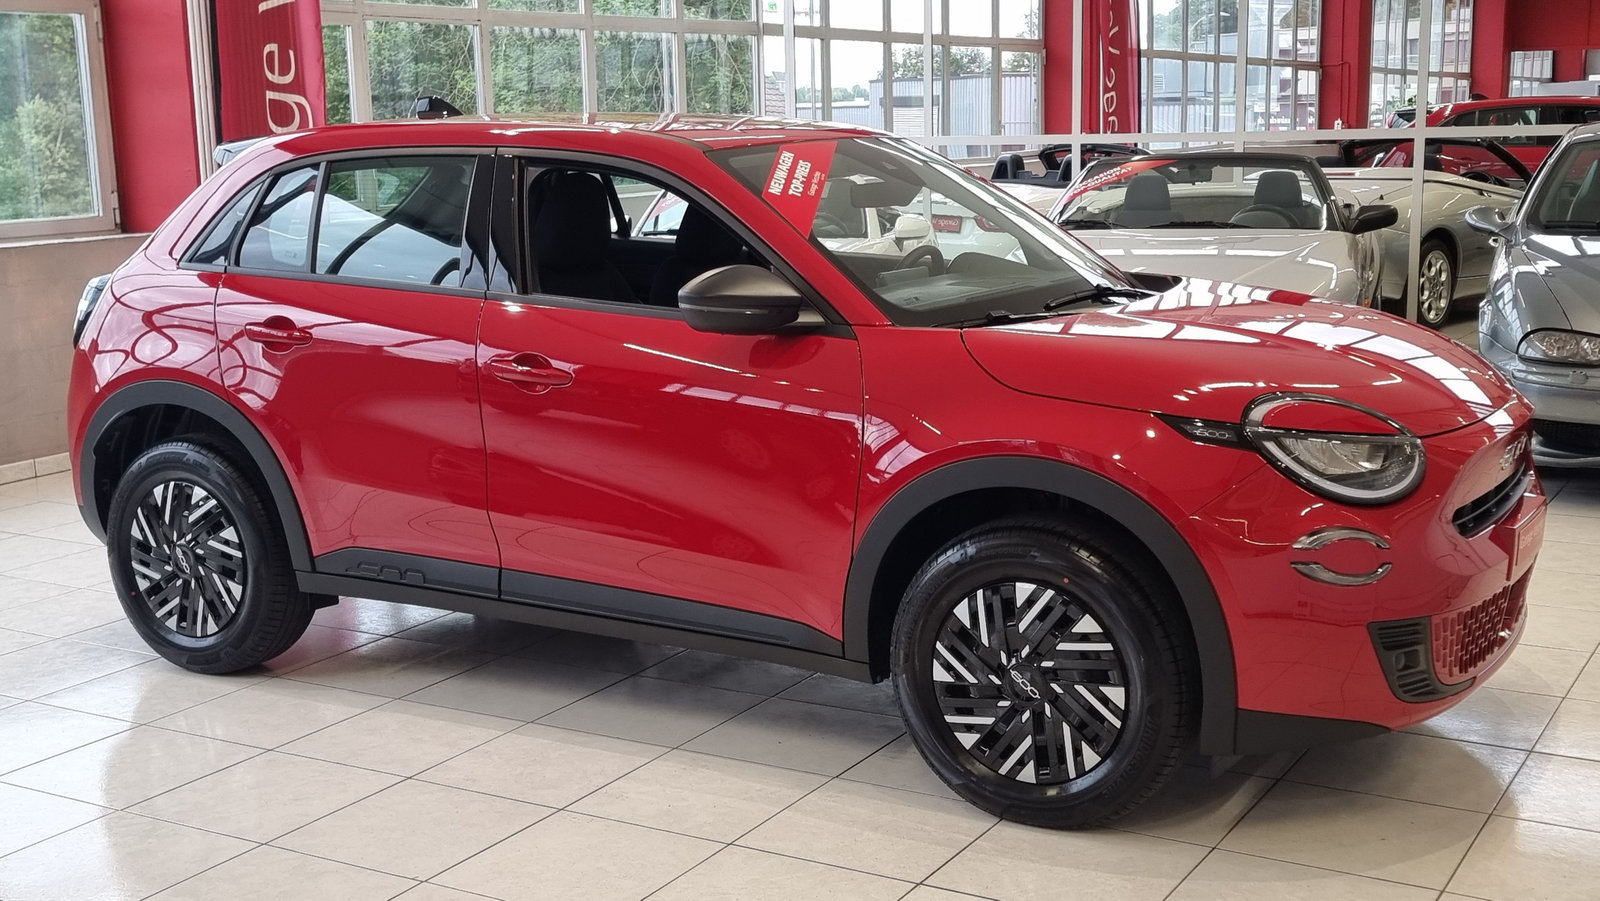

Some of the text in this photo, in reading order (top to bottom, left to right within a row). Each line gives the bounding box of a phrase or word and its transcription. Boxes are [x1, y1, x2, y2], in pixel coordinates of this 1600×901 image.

[768, 150, 795, 196] NEUWAGEN
[788, 159, 811, 197] TOP-PREIS
[1075, 166, 1121, 190] OCCASION
[1193, 428, 1231, 439] 600
[175, 545, 190, 575] 600
[1010, 669, 1041, 698] 600
